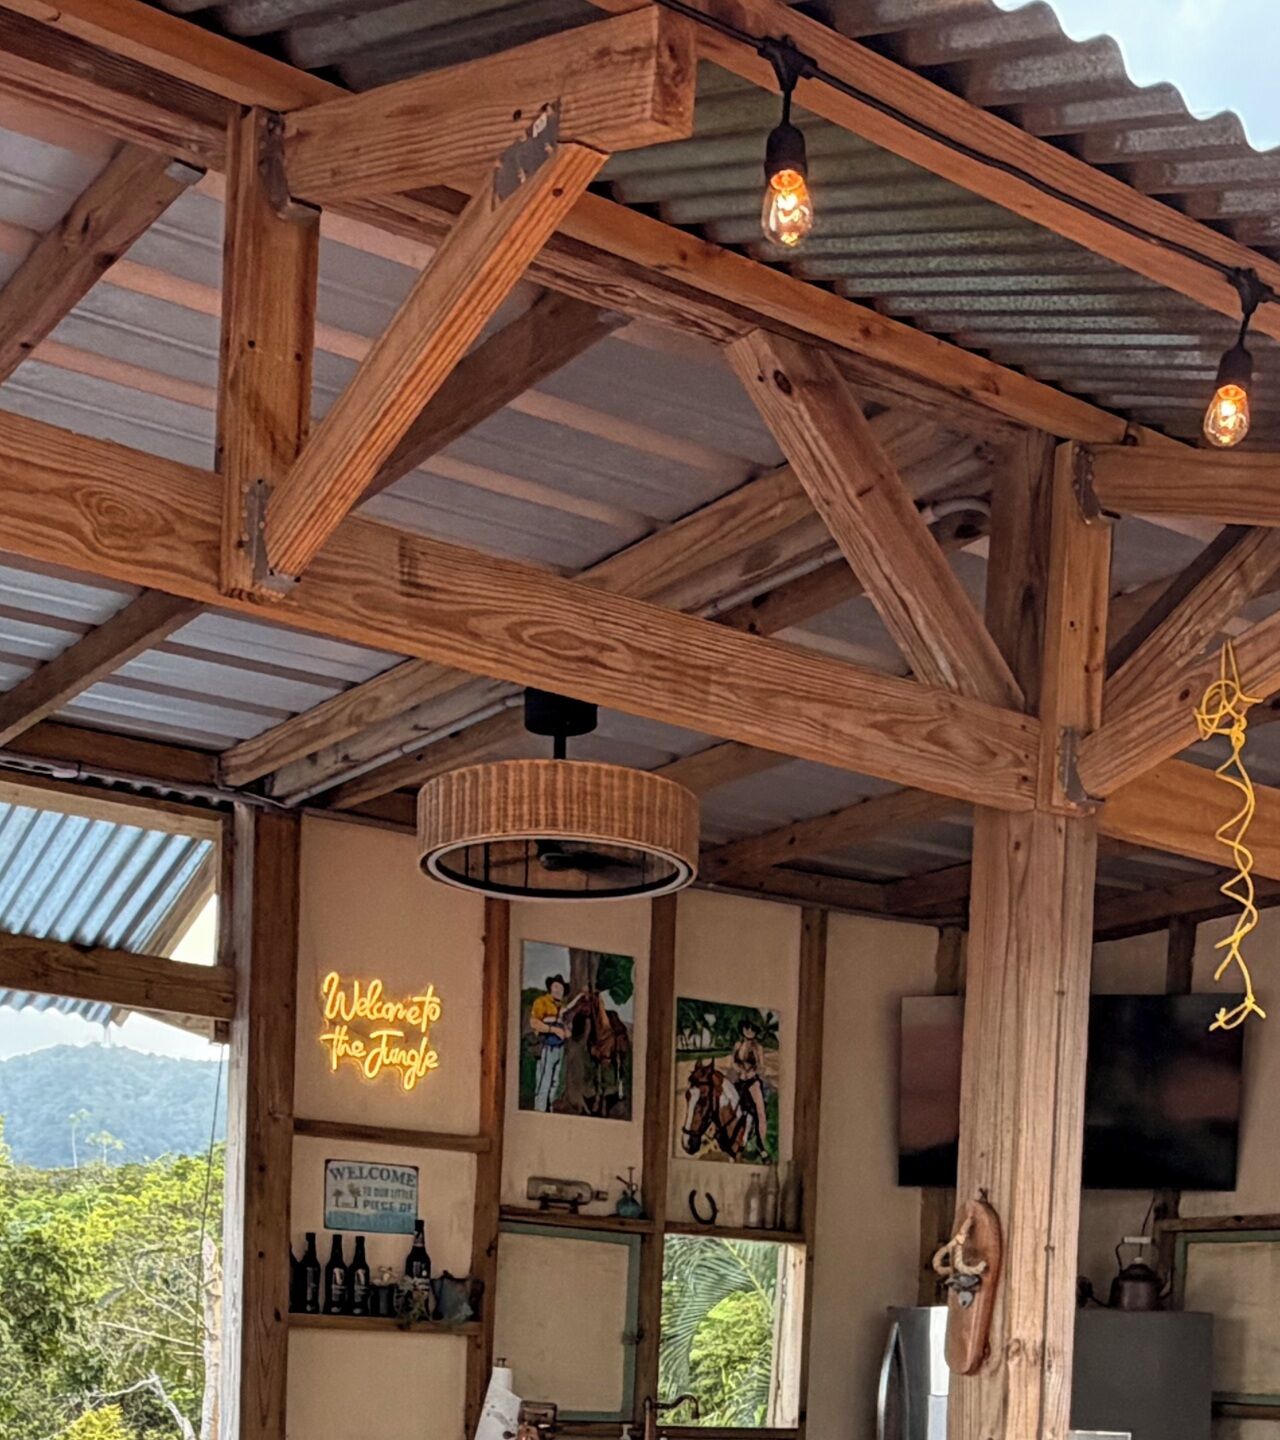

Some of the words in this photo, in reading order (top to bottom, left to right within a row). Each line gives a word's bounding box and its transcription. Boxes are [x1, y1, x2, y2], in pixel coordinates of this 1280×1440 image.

[322, 971, 421, 1025] Welcome
[412, 984, 441, 1032] to
[319, 1025, 367, 1070] the
[364, 1030, 438, 1090] Jungle
[330, 1166, 416, 1188] WELCOME
[363, 1199, 394, 1211] PIECE
